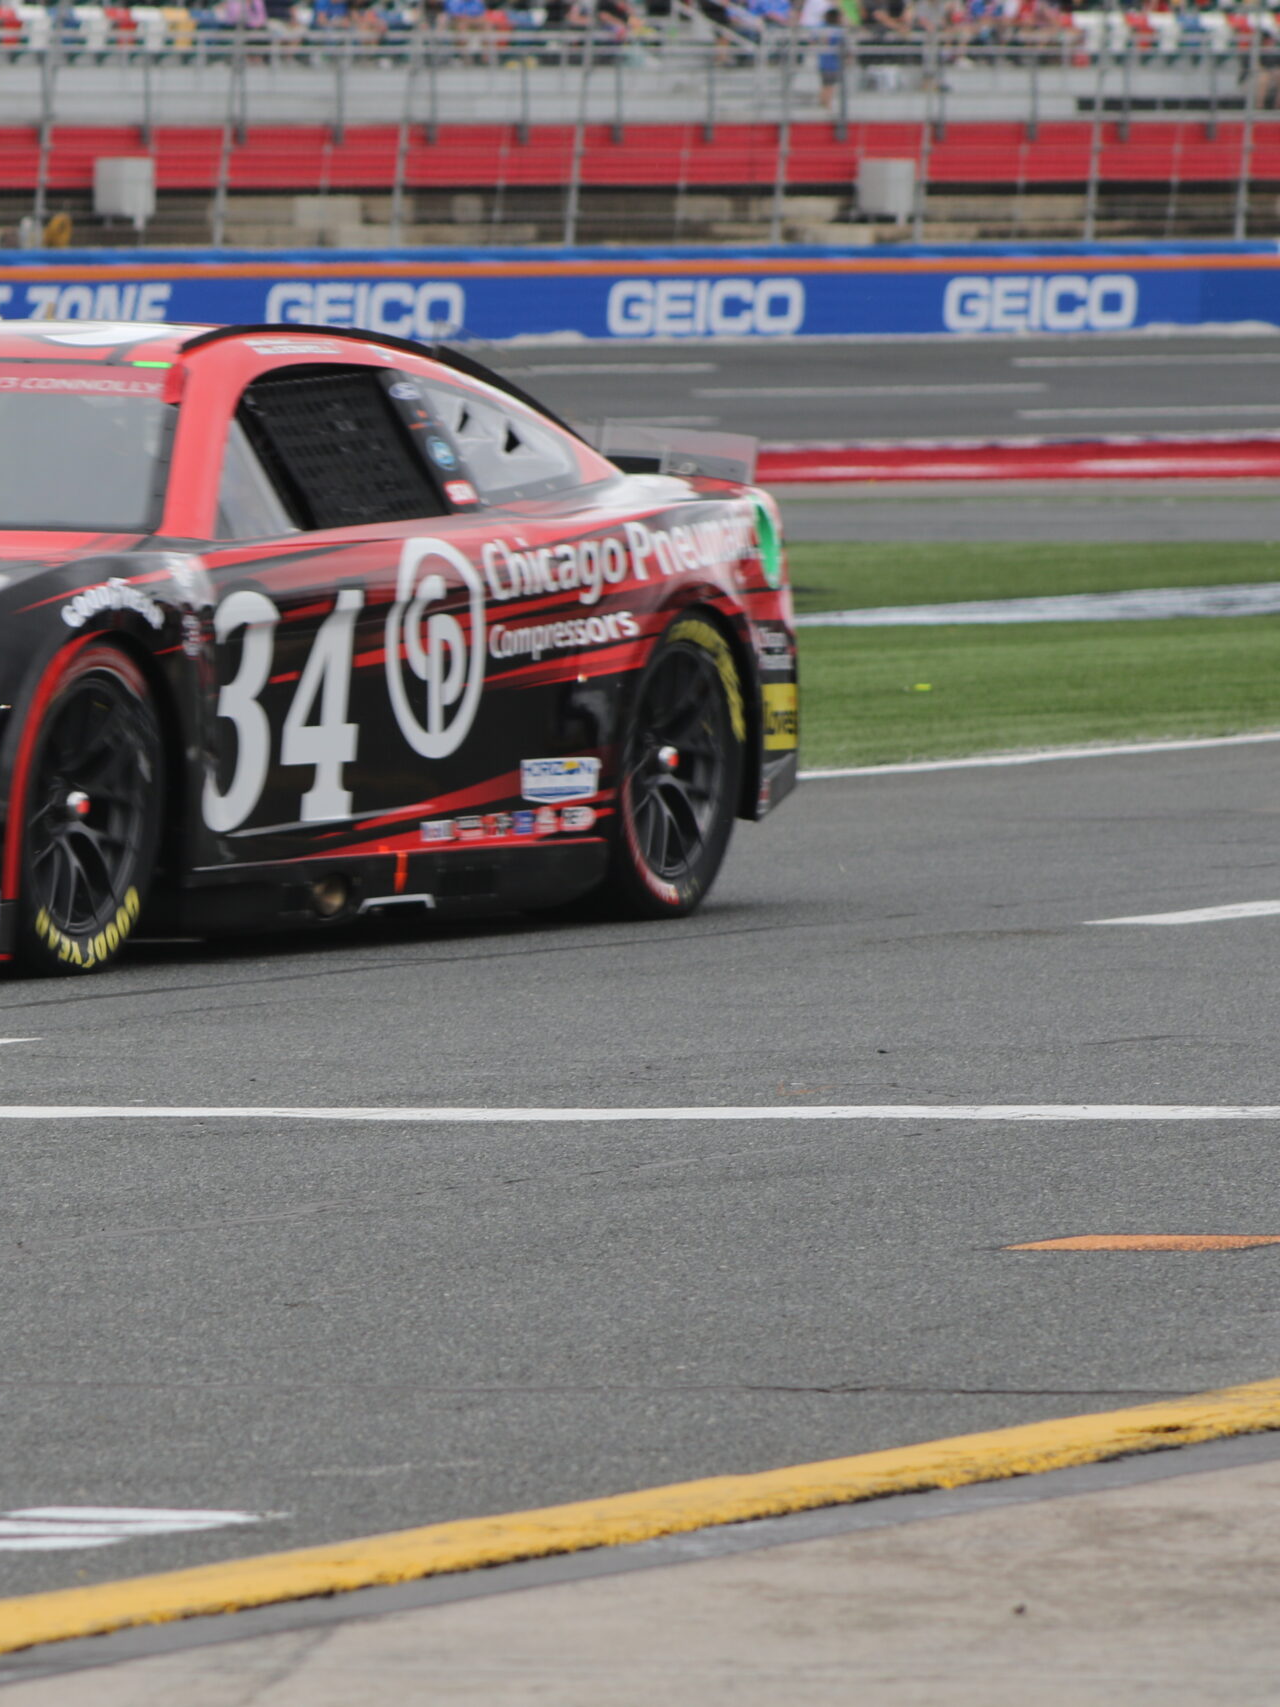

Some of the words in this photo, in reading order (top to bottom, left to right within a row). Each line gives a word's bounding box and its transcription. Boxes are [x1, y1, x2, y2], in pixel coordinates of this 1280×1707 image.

[24, 283, 172, 322] ZONE
[265, 281, 466, 338] GEICO
[606, 278, 805, 337] GEICO
[942, 274, 1138, 332] GEICO
[482, 537, 628, 605] Chicago
[623, 520, 763, 581] Pneuma
[488, 610, 640, 660] Compressors
[201, 589, 365, 832] 34
[35, 885, 140, 969] GOODYEAR
